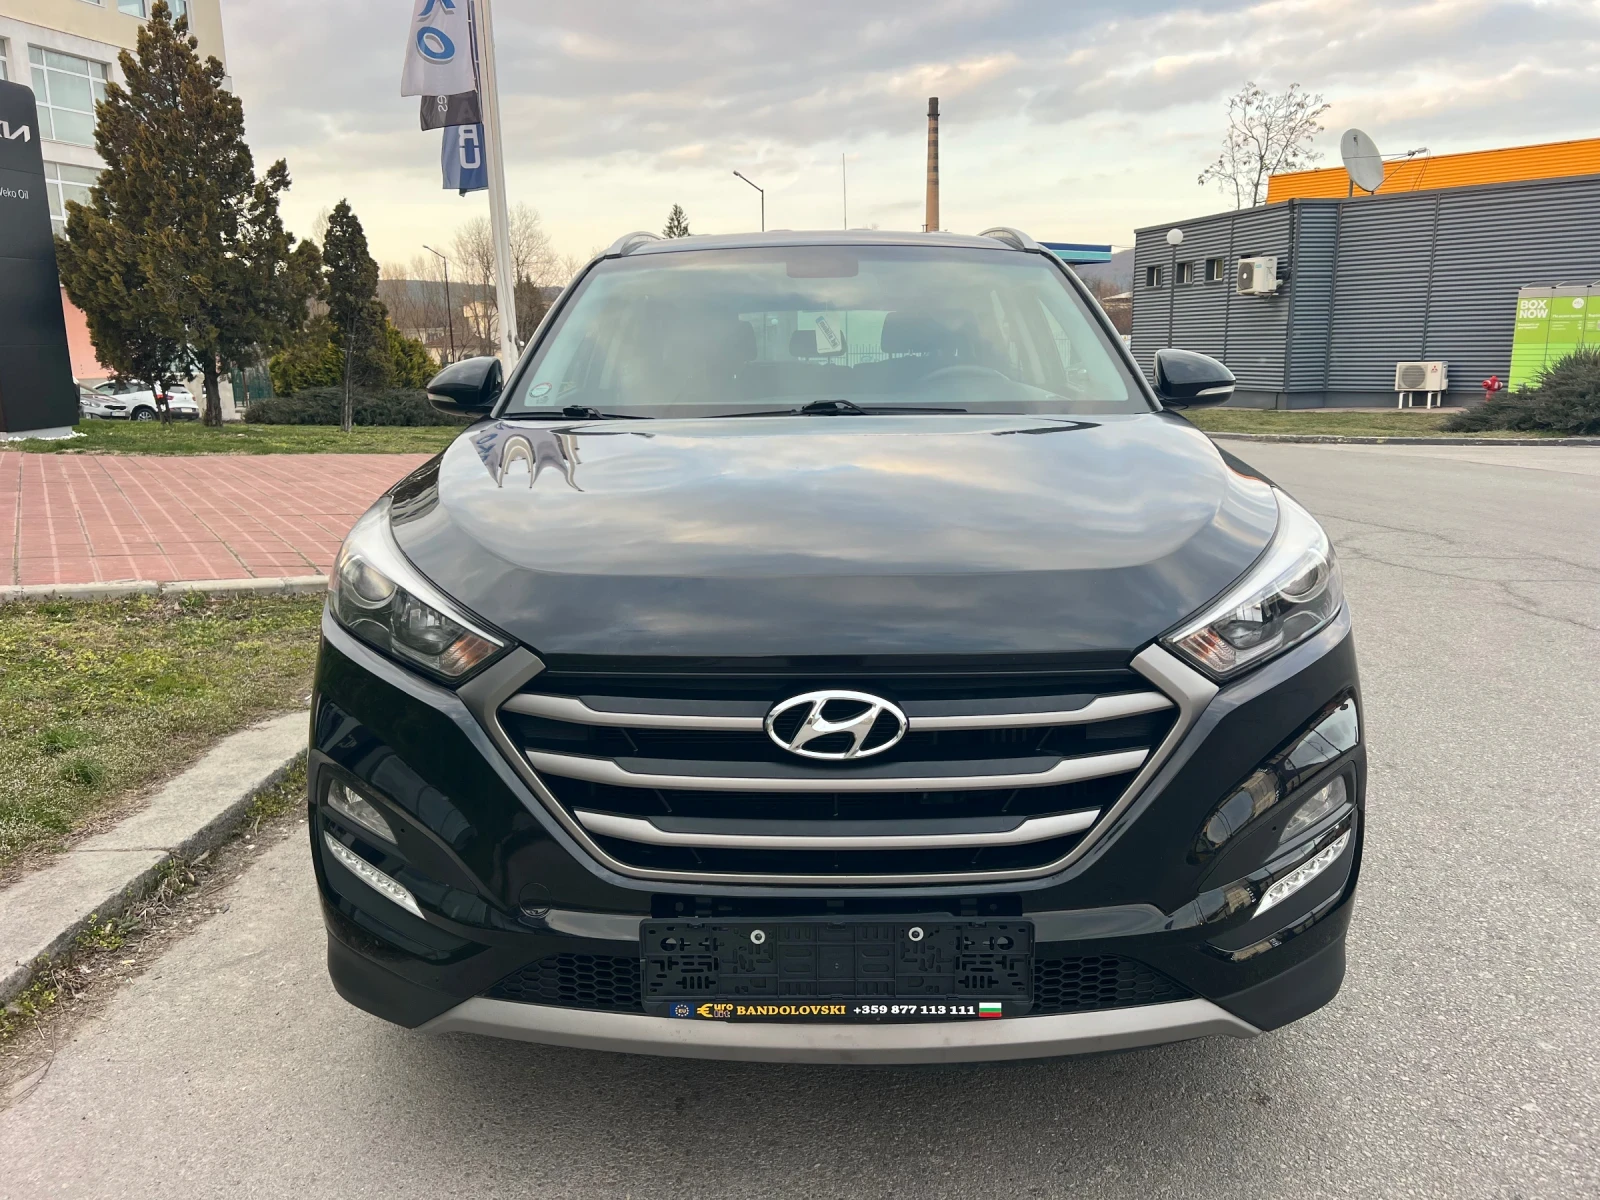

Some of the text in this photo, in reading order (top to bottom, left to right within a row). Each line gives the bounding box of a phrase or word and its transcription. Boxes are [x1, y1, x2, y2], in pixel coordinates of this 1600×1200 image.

[18, 189, 29, 199] Oil
[1520, 299, 1548, 310] BOX
[1519, 309, 1549, 319] NOW
[736, 1005, 846, 1015] BANDOLOVSKI
[853, 1005, 888, 1015] +359
[891, 1005, 917, 1015] 877
[920, 1005, 947, 1015] 113
[949, 1005, 976, 1015] 111
